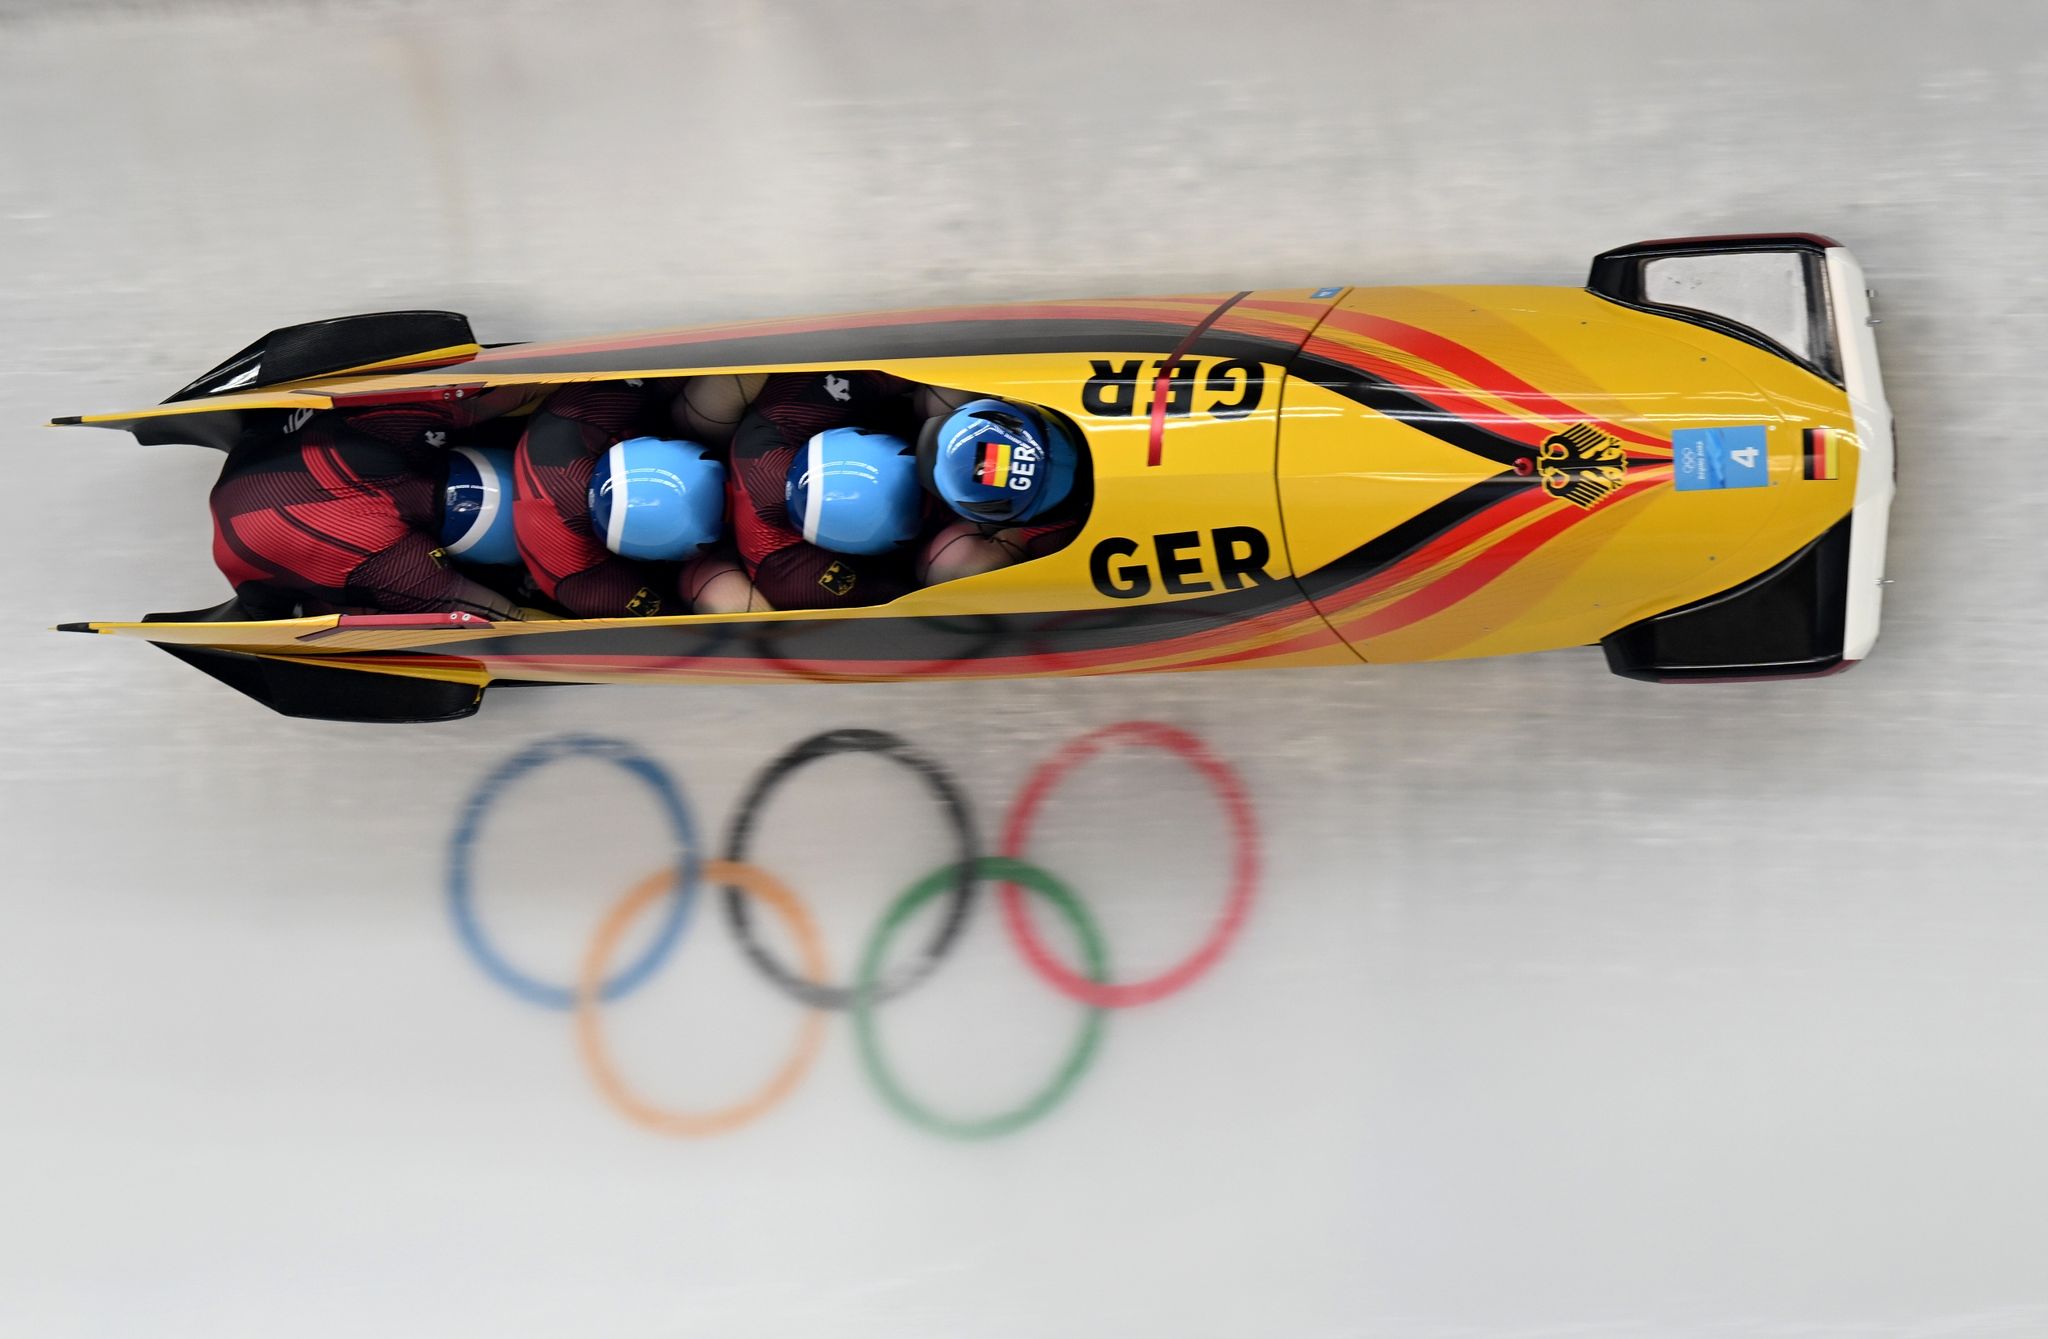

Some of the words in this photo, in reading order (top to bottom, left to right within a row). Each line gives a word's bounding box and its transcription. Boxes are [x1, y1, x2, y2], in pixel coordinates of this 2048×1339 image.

[1081, 358, 1265, 420] GER
[1009, 445, 1036, 491] GER
[1730, 446, 1760, 469] 4
[1089, 525, 1275, 599] GER
